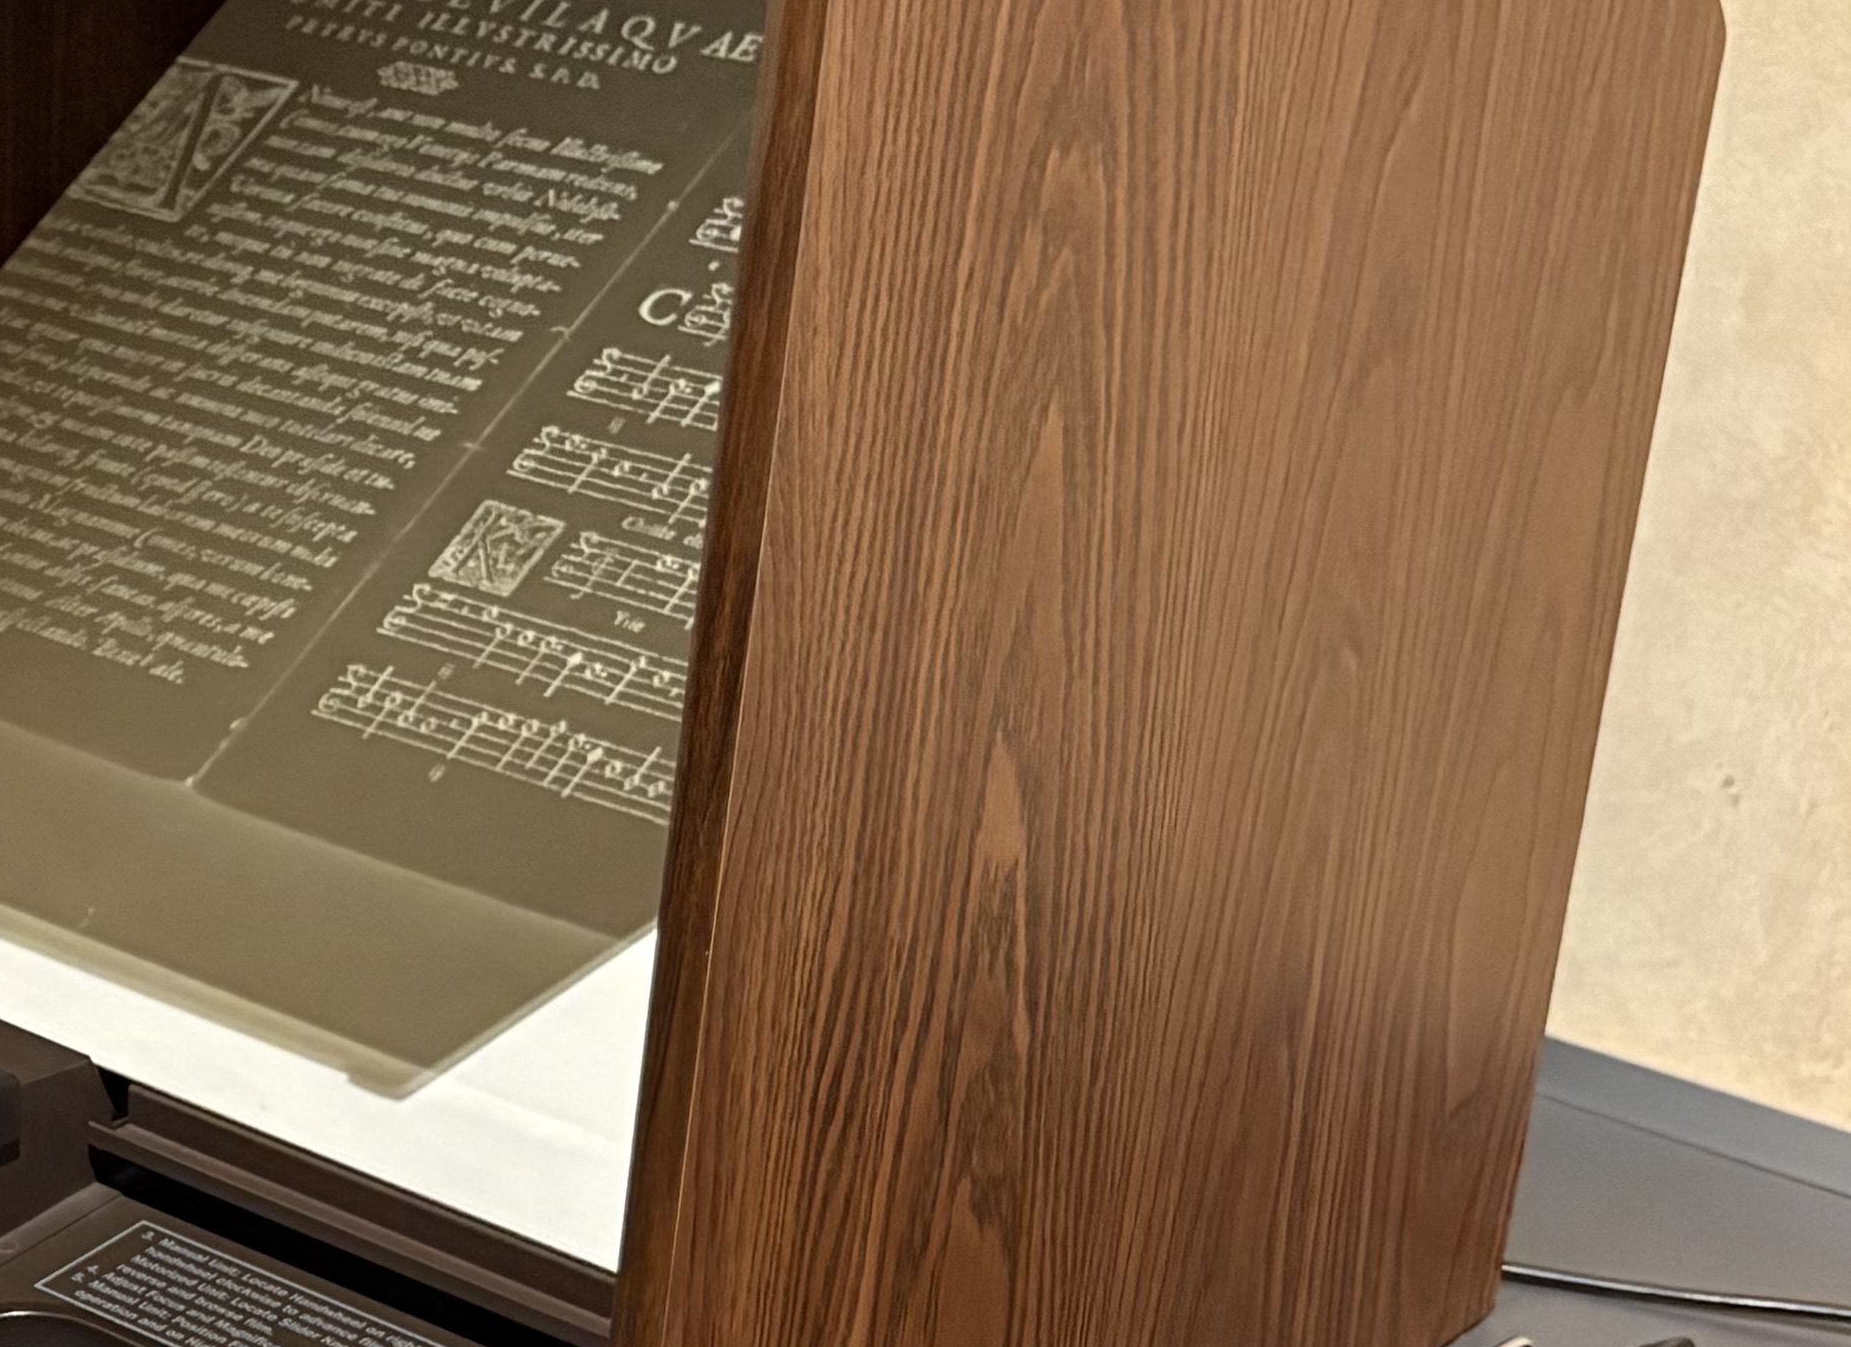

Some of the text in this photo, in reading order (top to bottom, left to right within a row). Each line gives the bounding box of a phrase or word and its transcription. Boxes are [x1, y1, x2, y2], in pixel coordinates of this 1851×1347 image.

[419, 13, 677, 73] ILLVSTRISSIMO
[639, 289, 693, 326] C
[241, 1273, 288, 1296] Locate
[74, 1290, 137, 1319] operation
[145, 1289, 185, 1310] Focus
[230, 1297, 277, 1321] Locate
